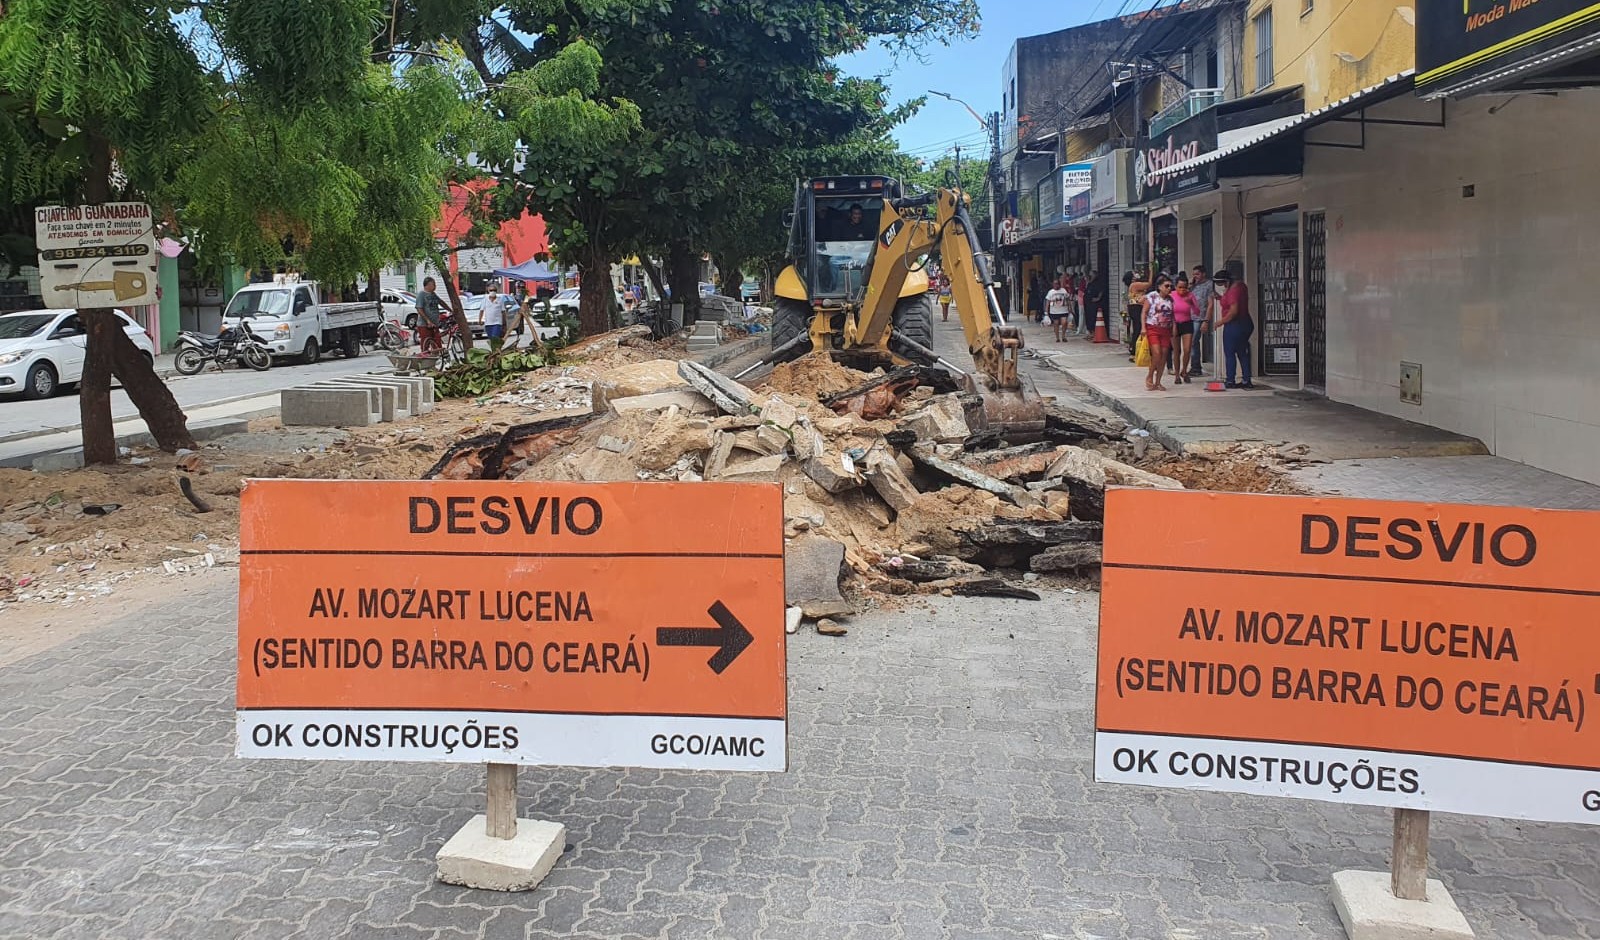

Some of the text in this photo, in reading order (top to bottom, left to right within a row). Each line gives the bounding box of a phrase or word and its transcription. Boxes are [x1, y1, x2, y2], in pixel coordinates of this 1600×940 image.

[1465, 4, 1505, 32] Moda
[1508, 0, 1541, 13] Ma
[1147, 134, 1199, 195] Stylosa
[37, 204, 150, 223] CHAVEIRO GUANABARA
[47, 223, 62, 231] Faça
[75, 221, 94, 230] chave
[107, 221, 112, 229] 2
[114, 220, 142, 228] minutos
[48, 231, 88, 239] ATENDEMOS
[107, 228, 143, 236] DOMICÍLIO
[409, 496, 602, 535] DESVIO
[1301, 514, 1536, 567] DESVIO
[309, 588, 593, 621] AV. MOZART LUCENA
[1179, 608, 1518, 661] AV. MOZART LUCENA
[254, 634, 649, 681] (SENTIDO BARRA DO CEARÁ)
[1116, 657, 1584, 732] (SENTIDO BARRA DO CEARÁ)
[253, 720, 764, 756] OK CONSTRUÇÕES GCO/AMC
[1114, 748, 1157, 773] OK
[1169, 751, 1419, 793] CONSTRUÇÕES
